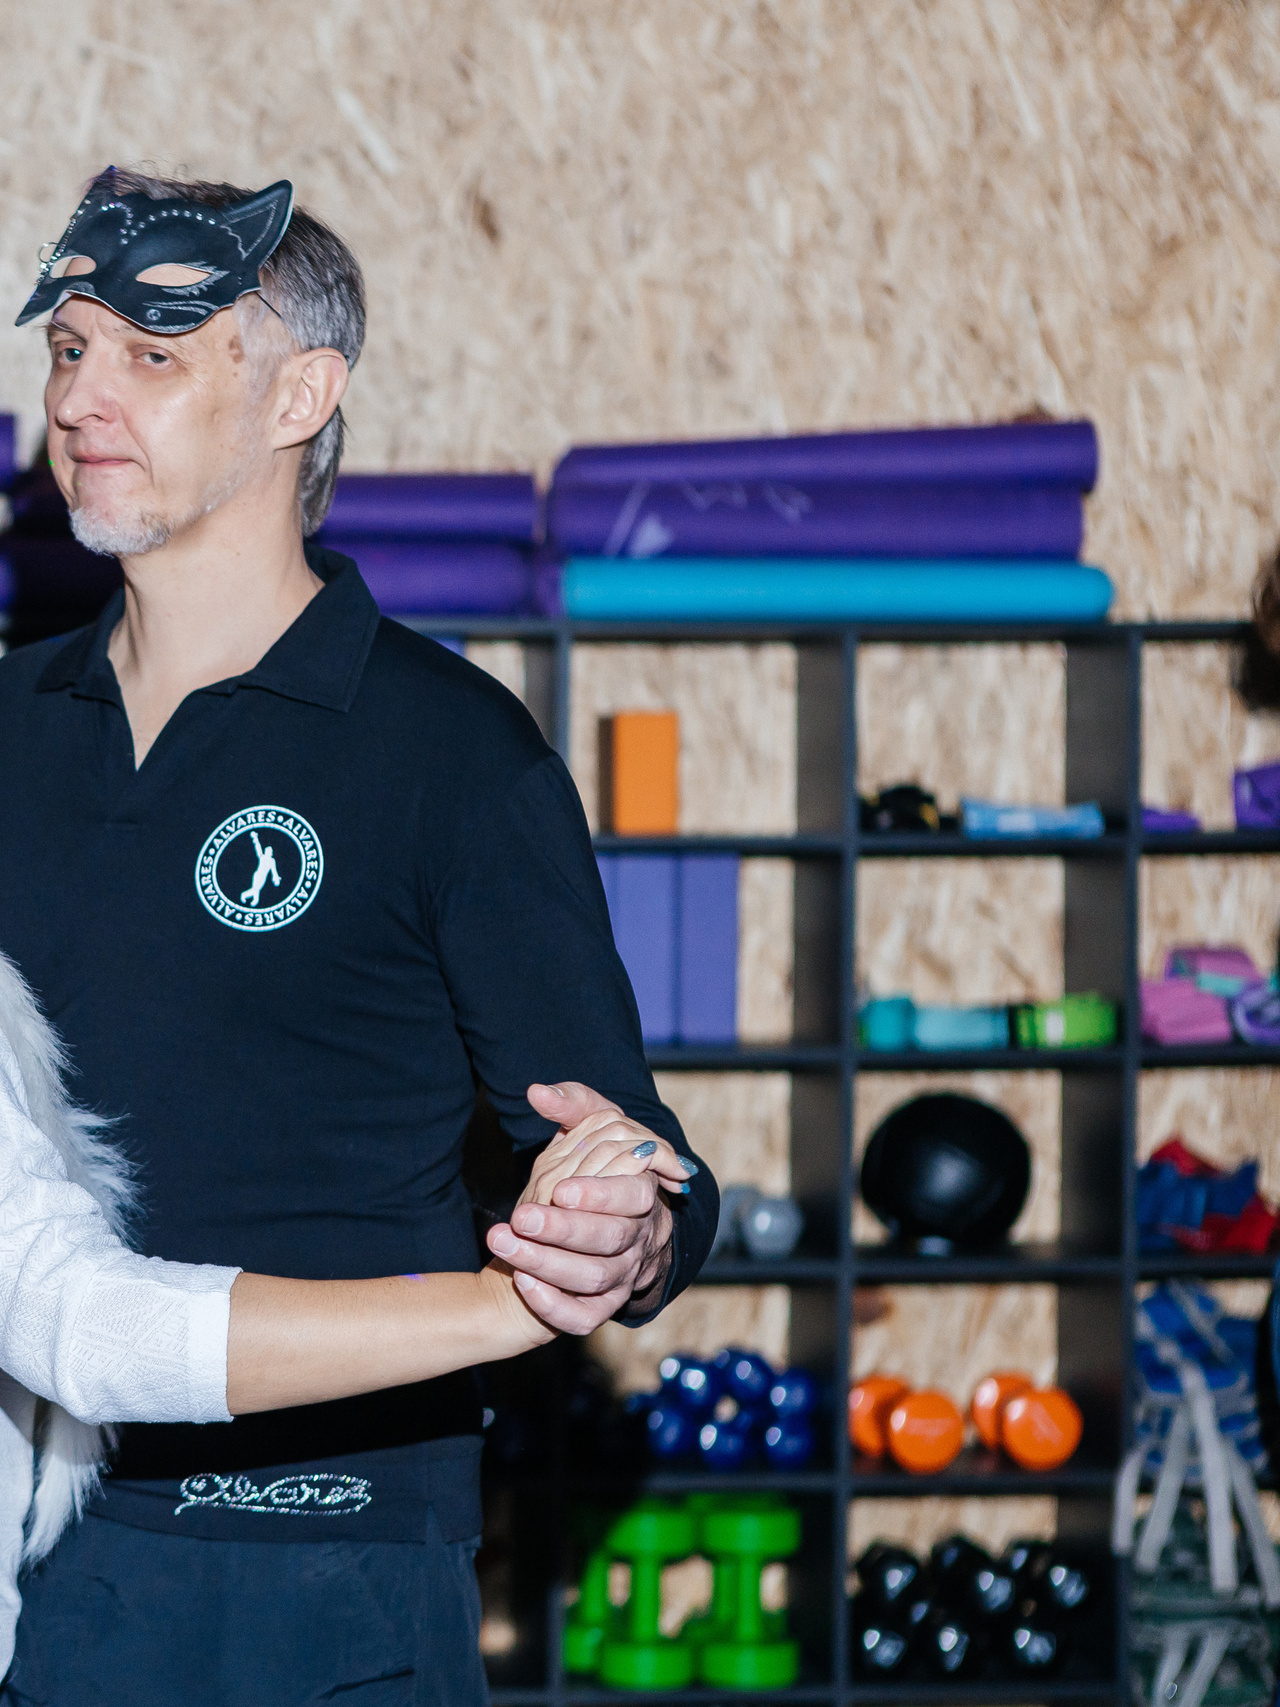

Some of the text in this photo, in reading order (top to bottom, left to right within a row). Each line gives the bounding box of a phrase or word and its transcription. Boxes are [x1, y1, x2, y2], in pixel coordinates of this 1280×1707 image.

[213, 811, 276, 849] ALVARES
[283, 817, 319, 881] ALVARES
[201, 855, 236, 918] ALVARES
[244, 886, 308, 926] ALVARES
